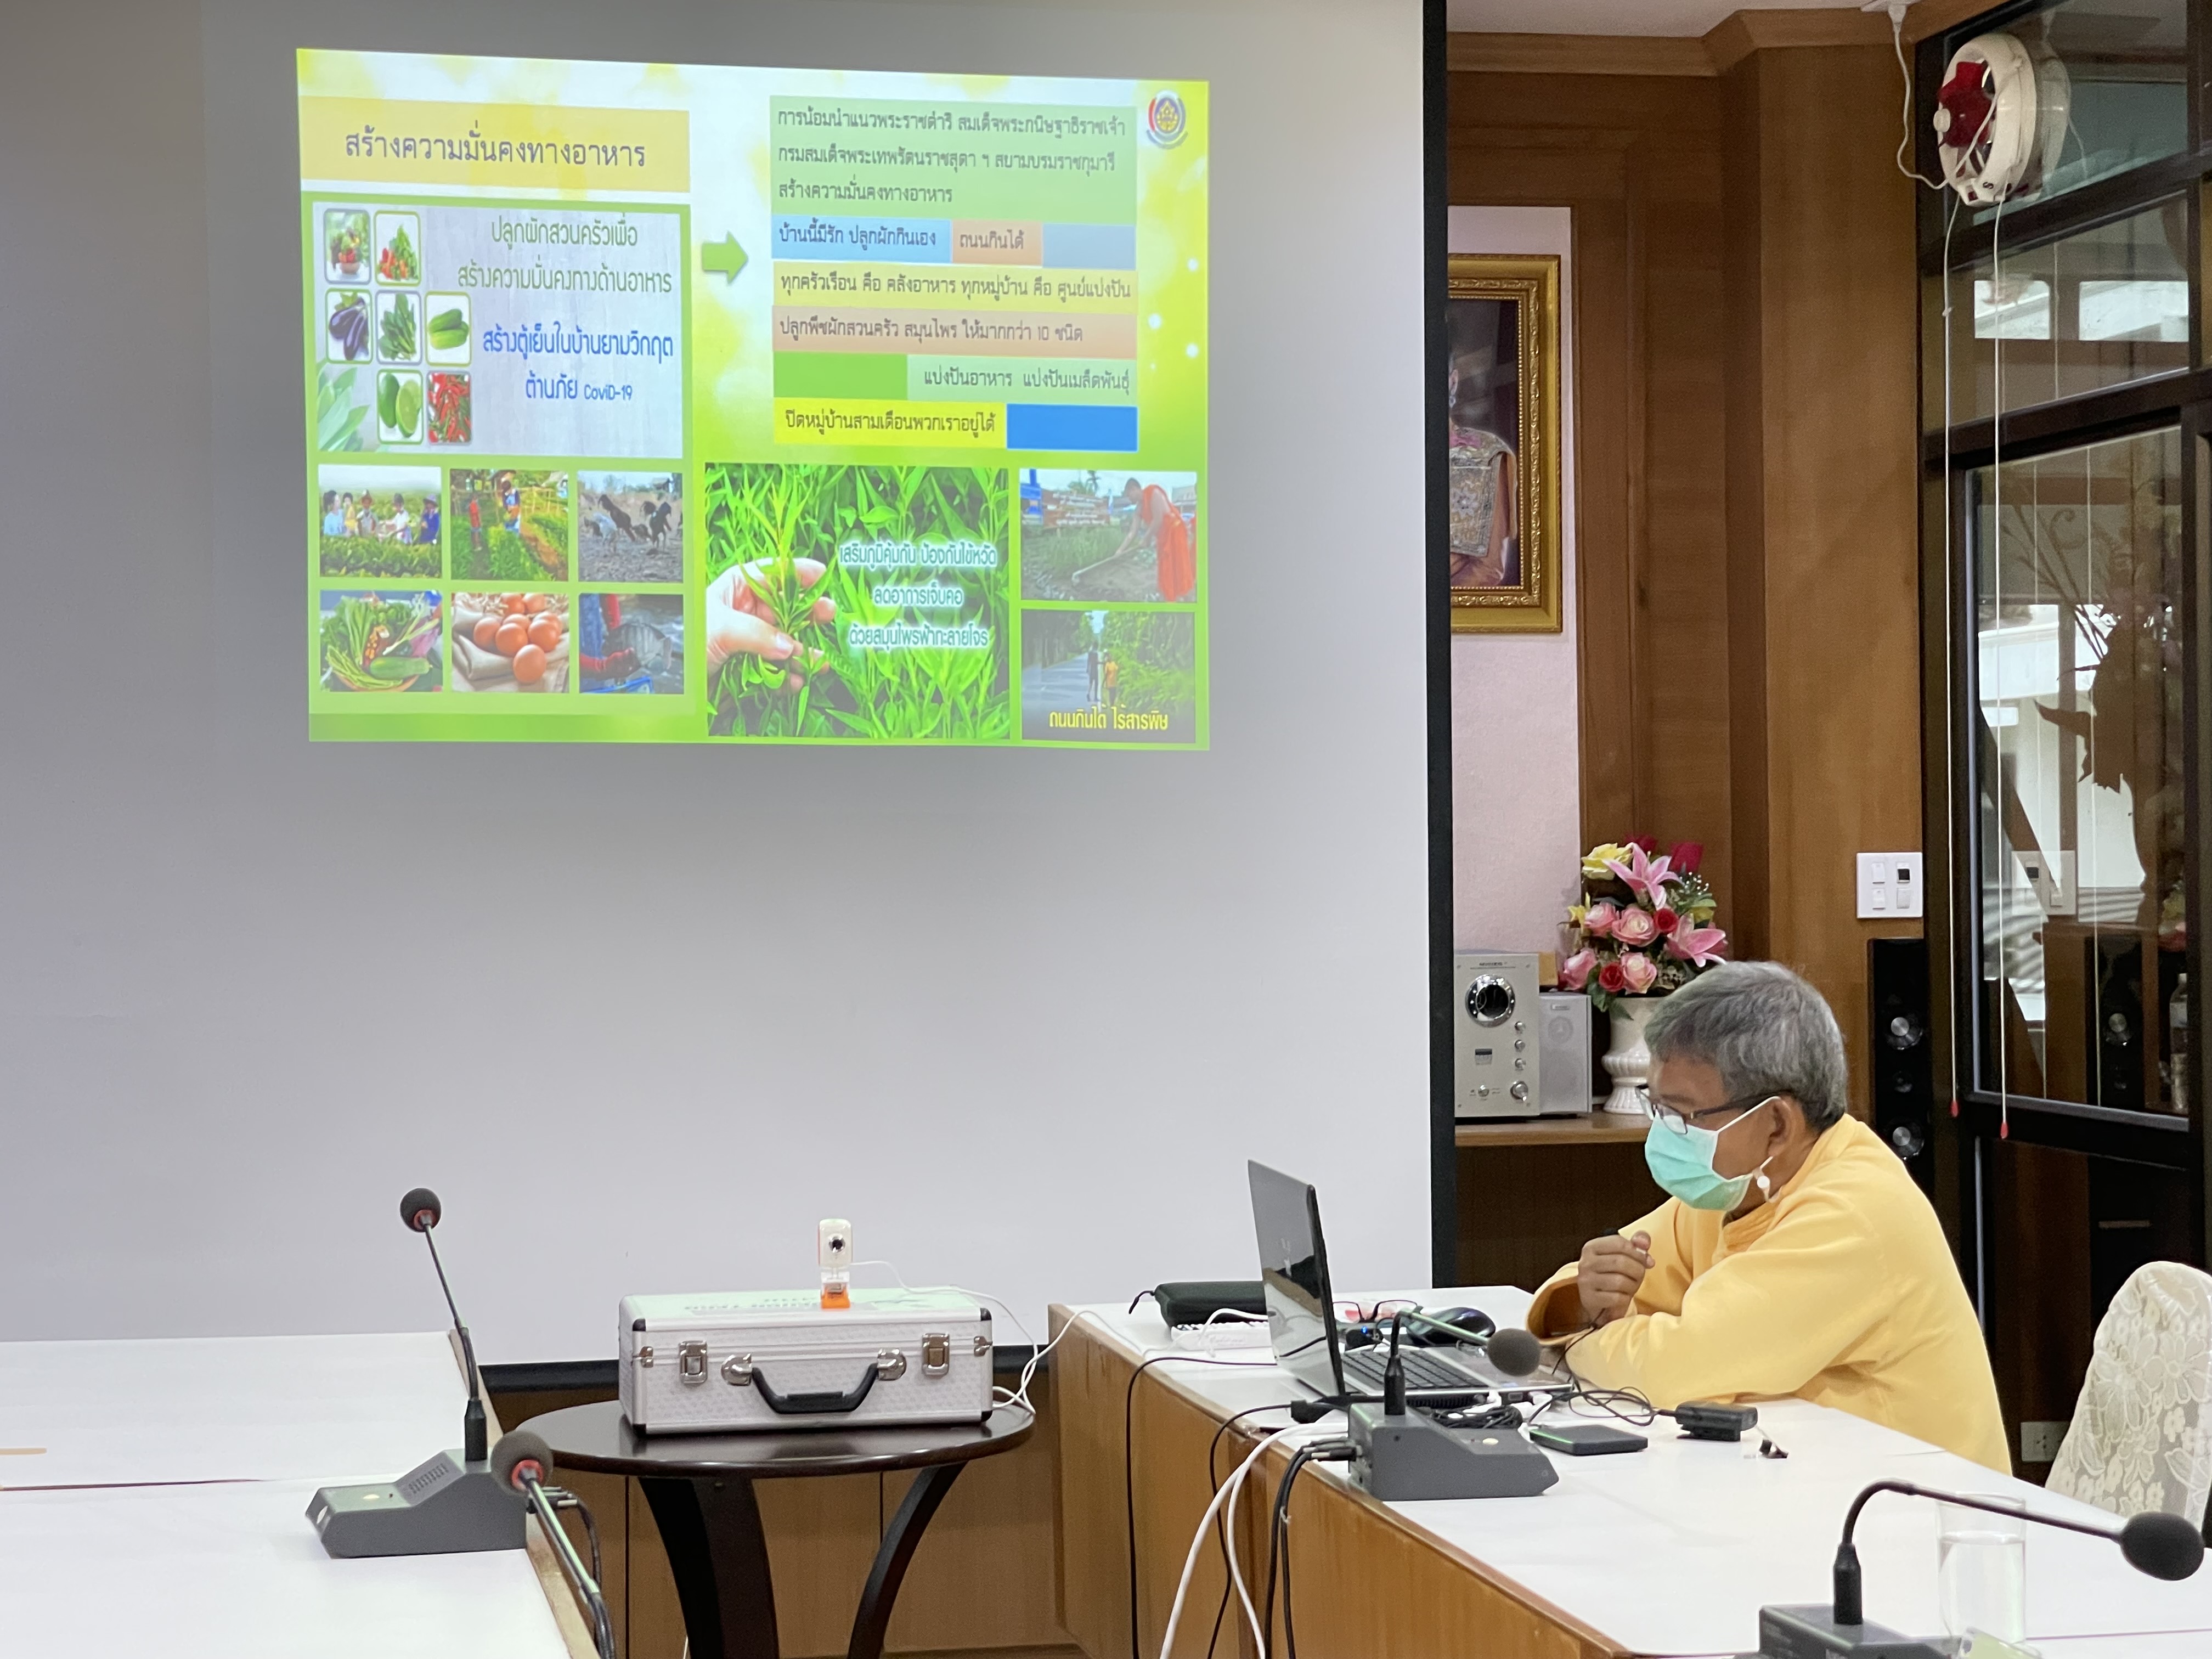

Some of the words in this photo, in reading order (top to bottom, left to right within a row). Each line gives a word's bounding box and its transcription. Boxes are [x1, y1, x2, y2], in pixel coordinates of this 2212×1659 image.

[345, 119, 646, 167] สร้างความมั่นคงทางอาหาร
[778, 143, 977, 173] กรมสมเด็จพระเทพรัตนราชสุดา
[995, 151, 1115, 177] สยามบรมราชกุมารี
[778, 174, 953, 203] สร้างความมั่นคงทางอาหาร
[491, 212, 638, 250] ปลูกผักสวนครัวเพื่อ
[779, 218, 844, 244] บ้านนี้มีรัก
[849, 225, 936, 251] ปลูกผักกินเอง
[960, 229, 1024, 250] ถนนกินได้
[458, 255, 673, 293] สร้างความมั่นคงทางด้านอาหาร
[781, 270, 857, 296] ทุกครัวเรือน
[863, 272, 881, 291] คือ
[887, 274, 956, 294] คลังอาหาร
[961, 274, 1028, 301] ทุกหมู่บ้าน
[1034, 276, 1052, 296] คือ
[1058, 276, 1131, 303] ศูนย์แบ่งปัน
[483, 320, 674, 364] สร้างตู้เย็นในบ้านยามวิกฤต
[780, 315, 899, 341] ปลูกพืชผักสวนครัว
[904, 317, 957, 343] สมุนไพร
[962, 318, 1032, 341] ให้มากกว่า
[1054, 323, 1084, 341] ชนิด
[924, 365, 1012, 387] แบ่งปันอาหาร
[1023, 367, 1130, 395] แบ่งปันเมล็ดพันธุ์
[785, 408, 996, 438] ปิดหมู่บ้านสามเดือนพวกเราอยู่ได้
[840, 542, 917, 568] เสริมภูมิคุ้มกัน
[921, 541, 997, 565] ป้องกันไข้หวัด
[874, 582, 963, 605] ลดอาการเจ็บคอ
[1049, 704, 1107, 729] ถนนกินได้
[1111, 704, 1168, 730] ไร้สารพิษ
